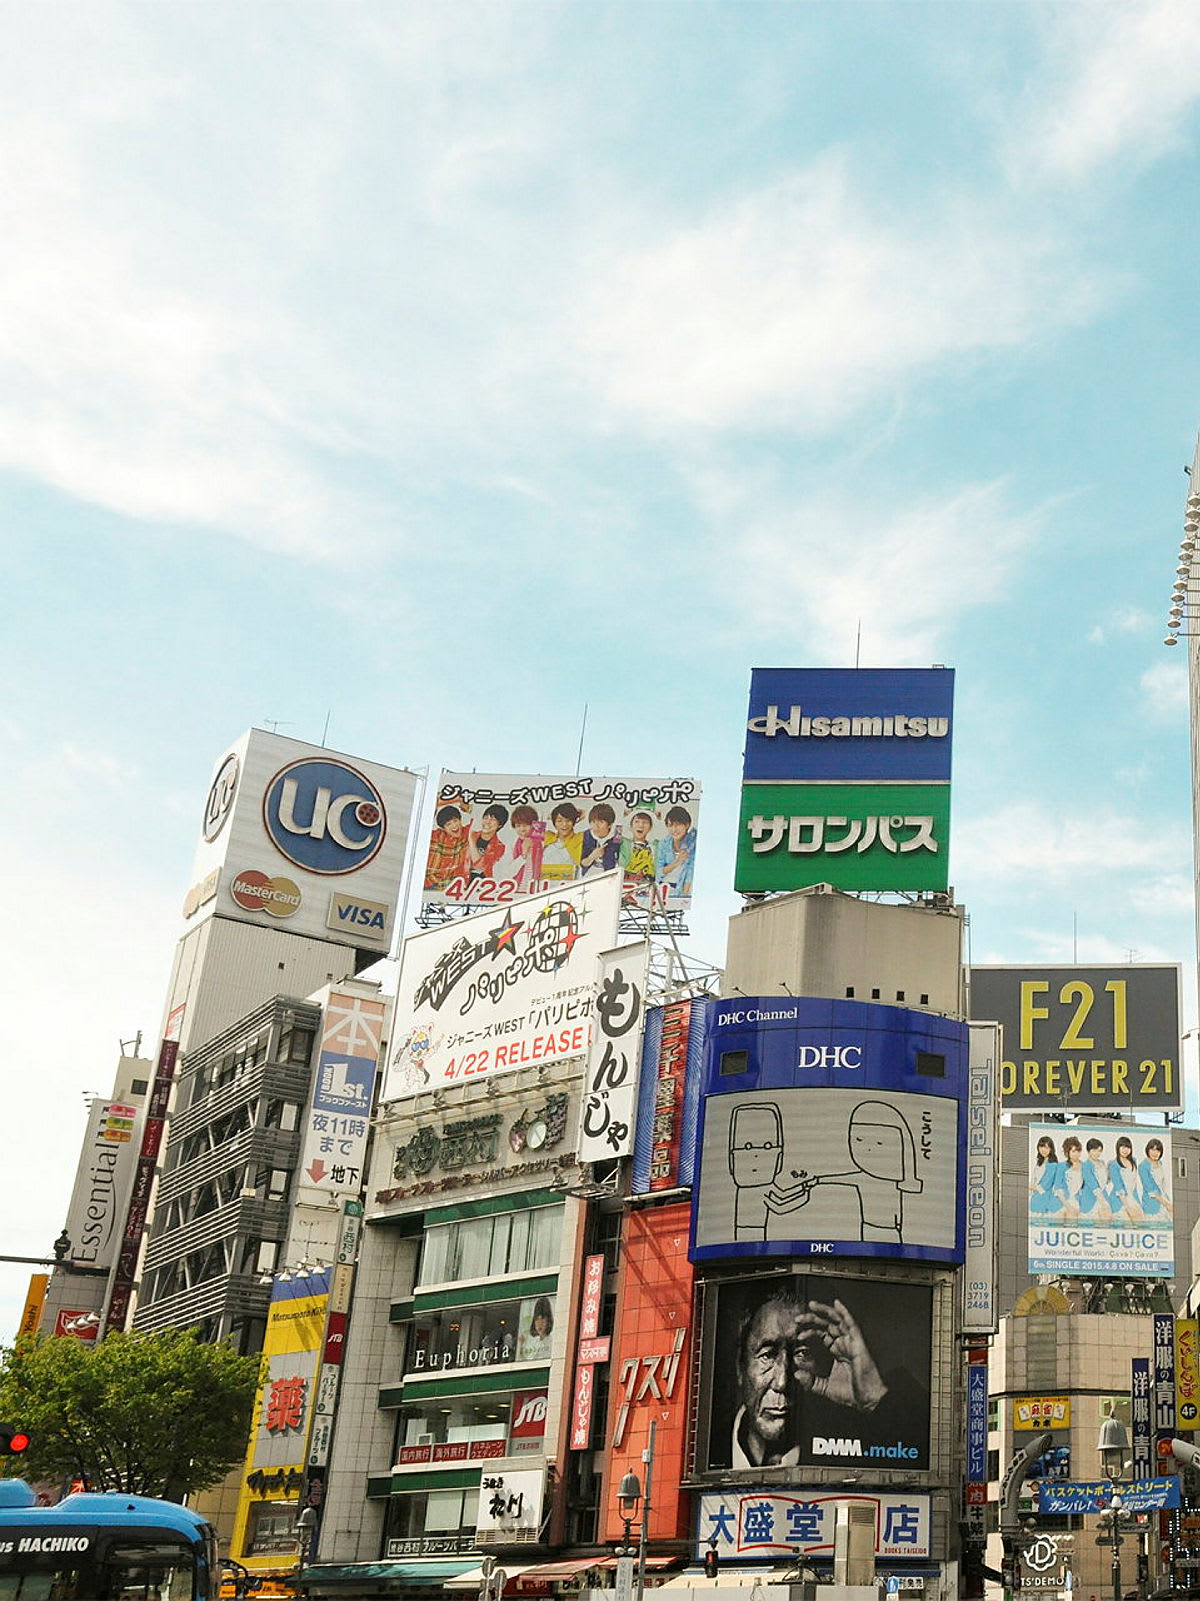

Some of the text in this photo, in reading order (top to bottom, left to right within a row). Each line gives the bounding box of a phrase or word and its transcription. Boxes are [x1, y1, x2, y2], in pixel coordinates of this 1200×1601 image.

[747, 705, 949, 737] Hisamitsu
[440, 778, 695, 808] ジャニーズWEST パリピポ
[747, 814, 939, 854] サロンパス
[233, 880, 301, 906] MasterCard
[445, 877, 514, 902] 4/22
[338, 904, 385, 930] VISA
[322, 998, 384, 1056] 本
[718, 1007, 798, 1027] DHC Channel
[1019, 979, 1128, 1050] F21
[446, 1017, 526, 1049] ジャニーズWEST
[444, 1051, 489, 1080] 4/22
[583, 968, 641, 1152] もんじゃ
[798, 1045, 862, 1069] DHC
[1001, 1058, 1173, 1094] OREVER 21
[318, 1094, 368, 1108] ブックファースト
[312, 1113, 366, 1138] 夜11時
[319, 1136, 354, 1156] まで
[330, 1163, 361, 1186] 地下
[70, 1142, 120, 1263] Essential
[810, 1242, 835, 1254] DHC
[1046, 1260, 1080, 1270] SINGLE
[1119, 1262, 1133, 1270] ON
[1134, 1262, 1159, 1272] SALE
[967, 1292, 989, 1300] 3719
[969, 1281, 988, 1291] (03)
[327, 1333, 343, 1343] JTB
[414, 1341, 510, 1371] Euphoria
[612, 1327, 686, 1448] クスリ
[1155, 1320, 1175, 1429] 洋服の青山
[266, 1376, 307, 1431] 薬
[513, 1396, 549, 1429] JTB
[1181, 1406, 1196, 1417] 4F
[970, 1373, 984, 1474] 大盛堂商事ビル
[435, 1445, 466, 1460] 海外旅行
[812, 1436, 919, 1460] DMM.make
[1048, 1500, 1093, 1512] ガンバレ!
[708, 1502, 920, 1544] 大盛堂店
[0, 1536, 89, 1553] us HACHIKO
[1020, 1577, 1065, 1587] TS'DEMO
